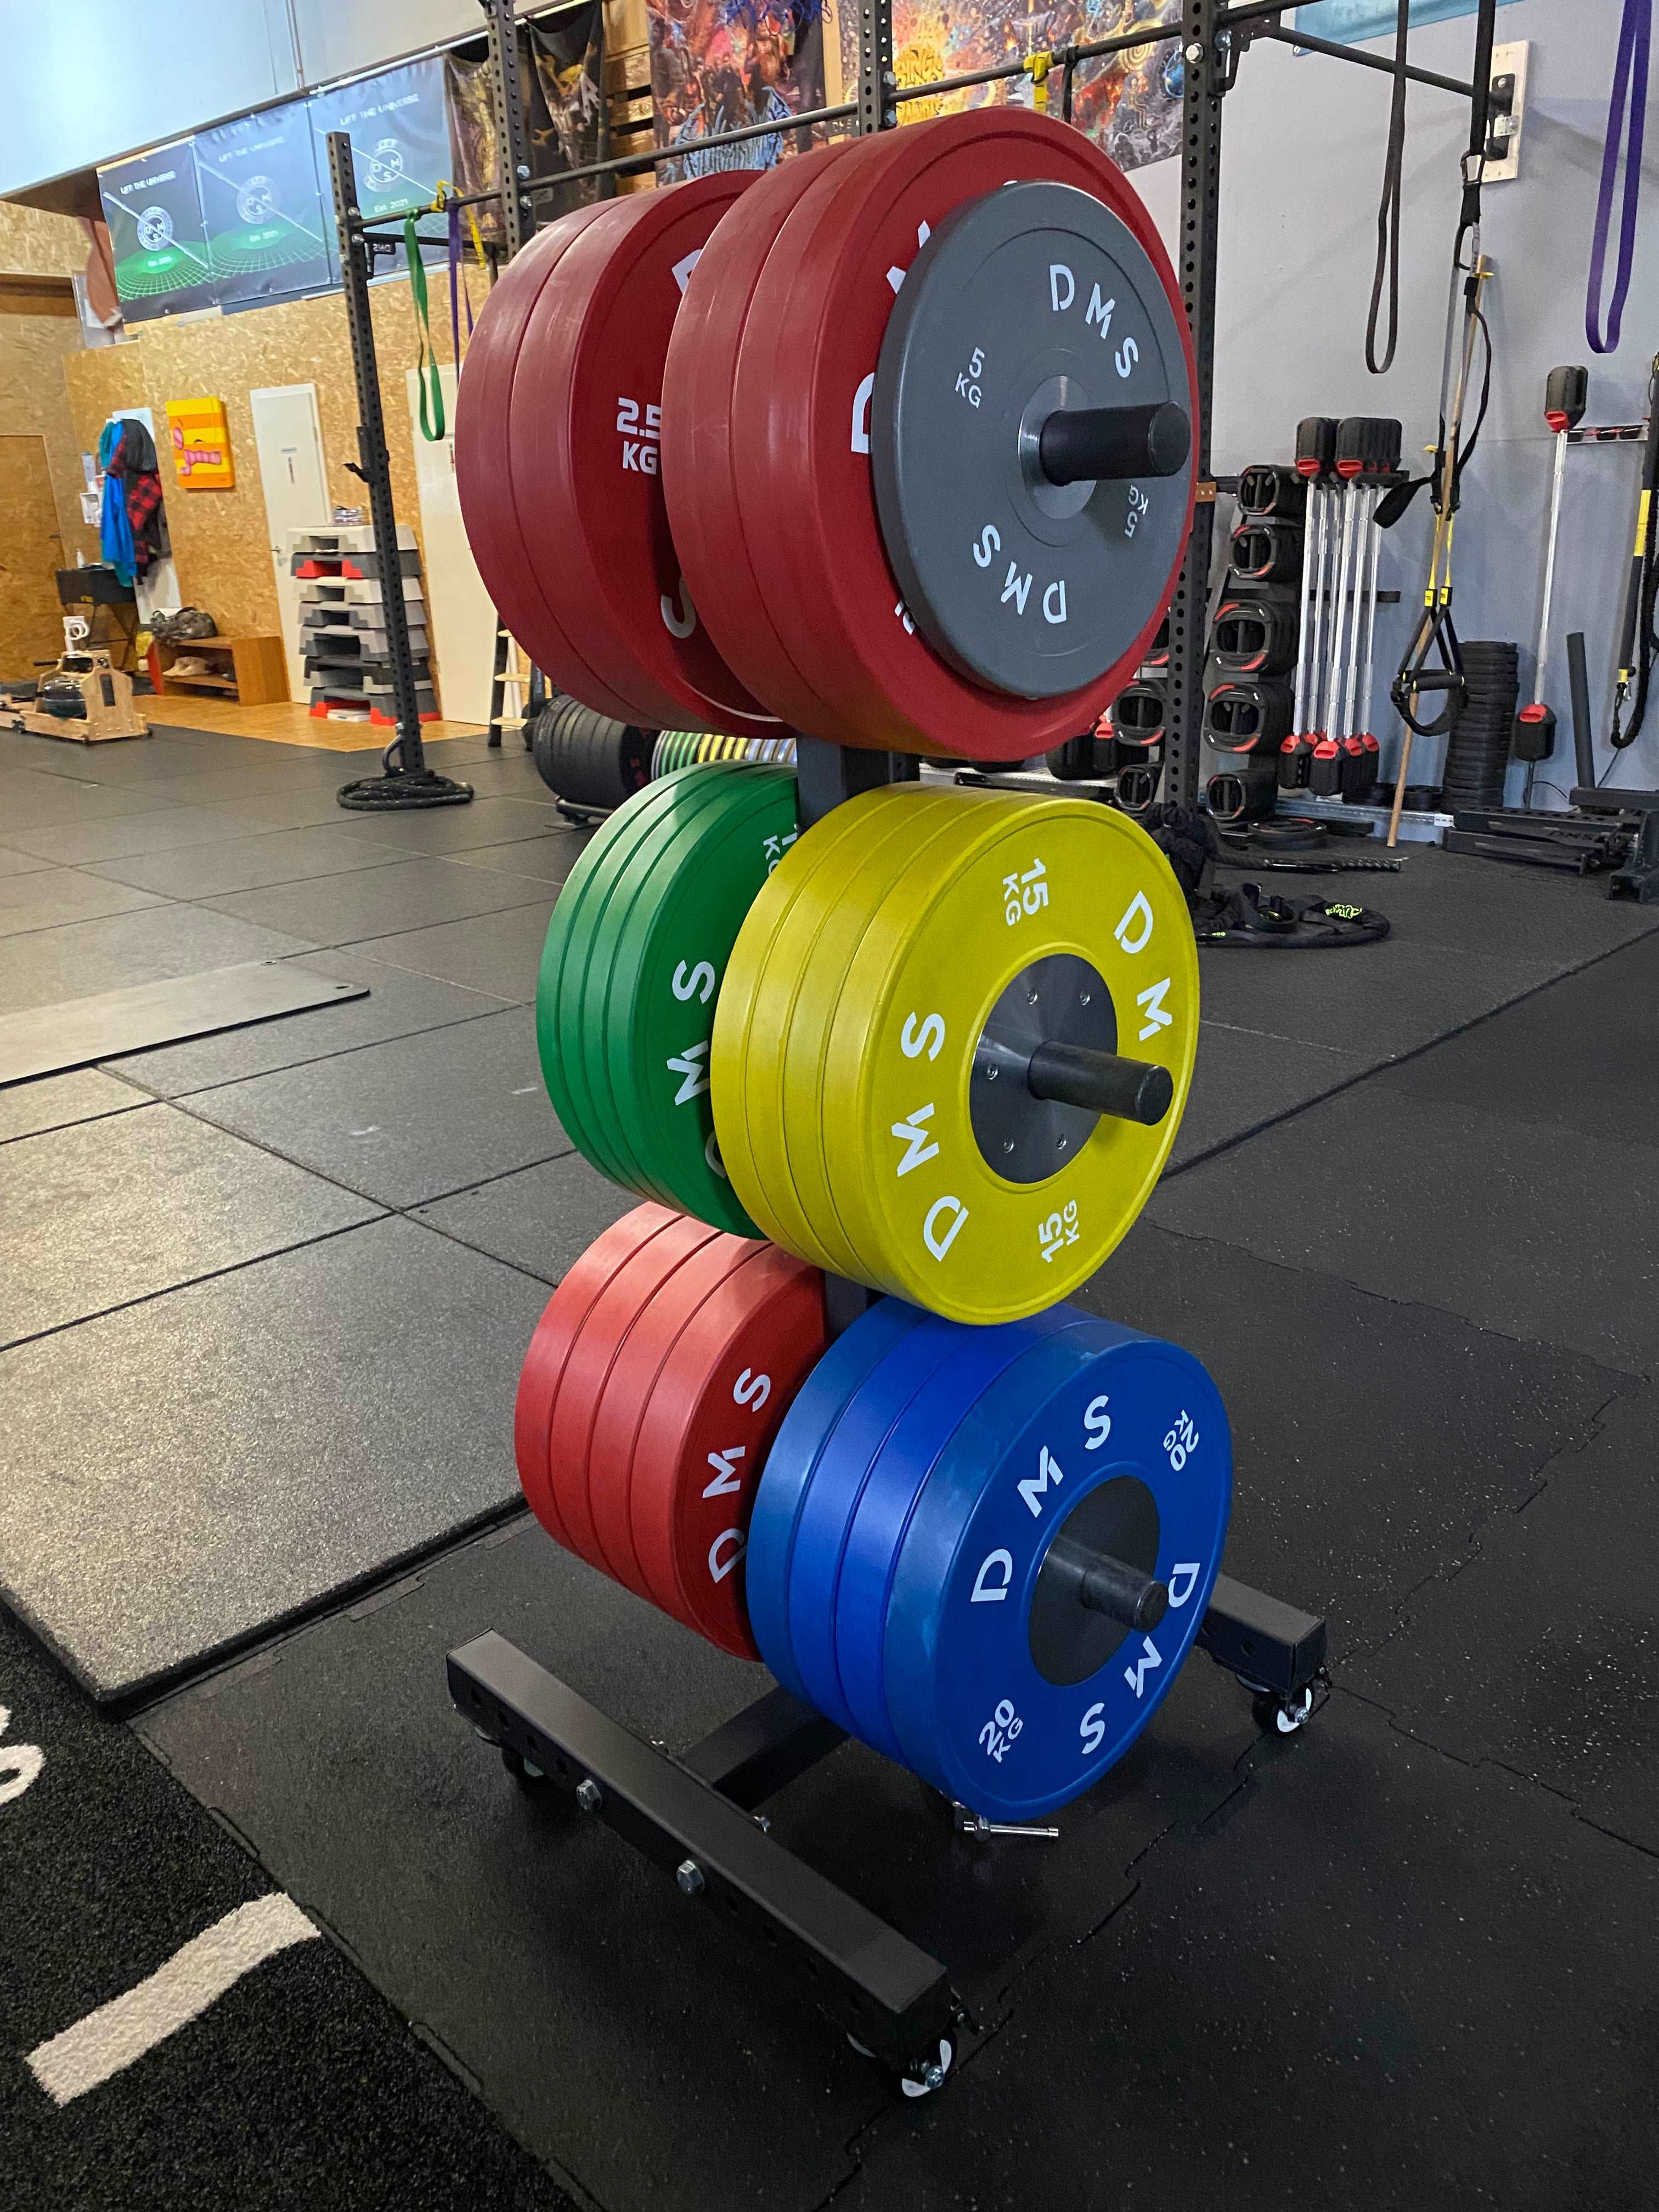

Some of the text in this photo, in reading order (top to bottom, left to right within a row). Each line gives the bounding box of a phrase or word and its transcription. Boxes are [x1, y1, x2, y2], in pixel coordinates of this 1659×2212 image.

[1049, 264, 1138, 378] DMS
[969, 347, 985, 378] 5
[955, 372, 982, 408] KG
[623, 440, 658, 475] KG
[1124, 511, 1138, 538] 5
[1128, 484, 1149, 515] KG
[973, 524, 1067, 624] DMS
[1002, 873, 1022, 926] KG
[1021, 858, 1049, 915] 15
[1114, 890, 1172, 1041] DM
[891, 1011, 969, 1262] DMS
[1039, 1213, 1064, 1263] 15
[1063, 1199, 1080, 1246] KG
[1163, 1409, 1189, 1451] KG
[1170, 1419, 1199, 1471] 20
[702, 1368, 771, 1583] DMS
[971, 1395, 1111, 1602] DMS
[1080, 1563, 1200, 1754] DMS
[979, 1699, 1014, 1756] 20
[993, 1718, 1023, 1763] KG
